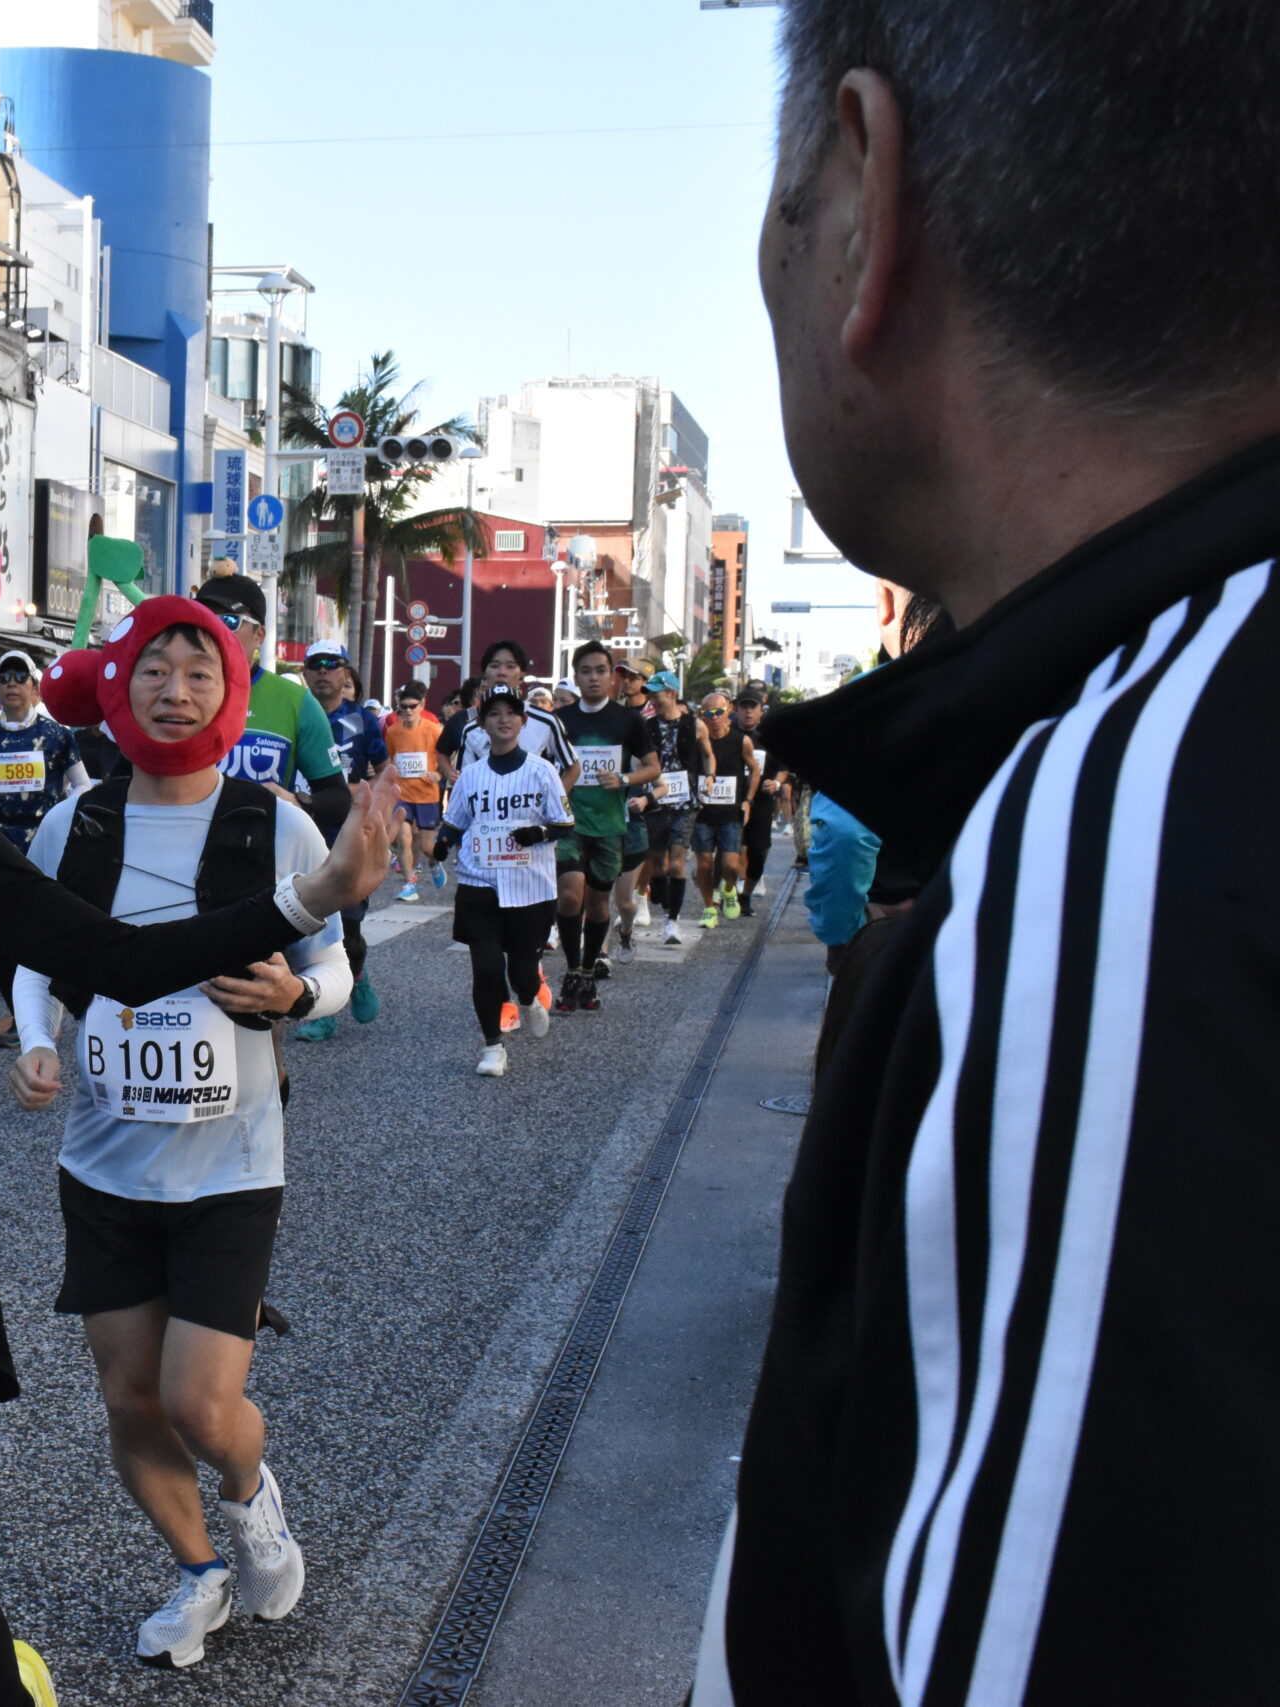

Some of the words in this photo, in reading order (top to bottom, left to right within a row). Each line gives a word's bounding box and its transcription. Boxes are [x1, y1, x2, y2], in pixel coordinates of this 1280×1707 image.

[6, 763, 35, 780] 589
[468, 789, 543, 820] Tigers
[472, 838, 480, 853] B
[88, 1034, 106, 1076] B
[118, 1039, 215, 1082] 1019
